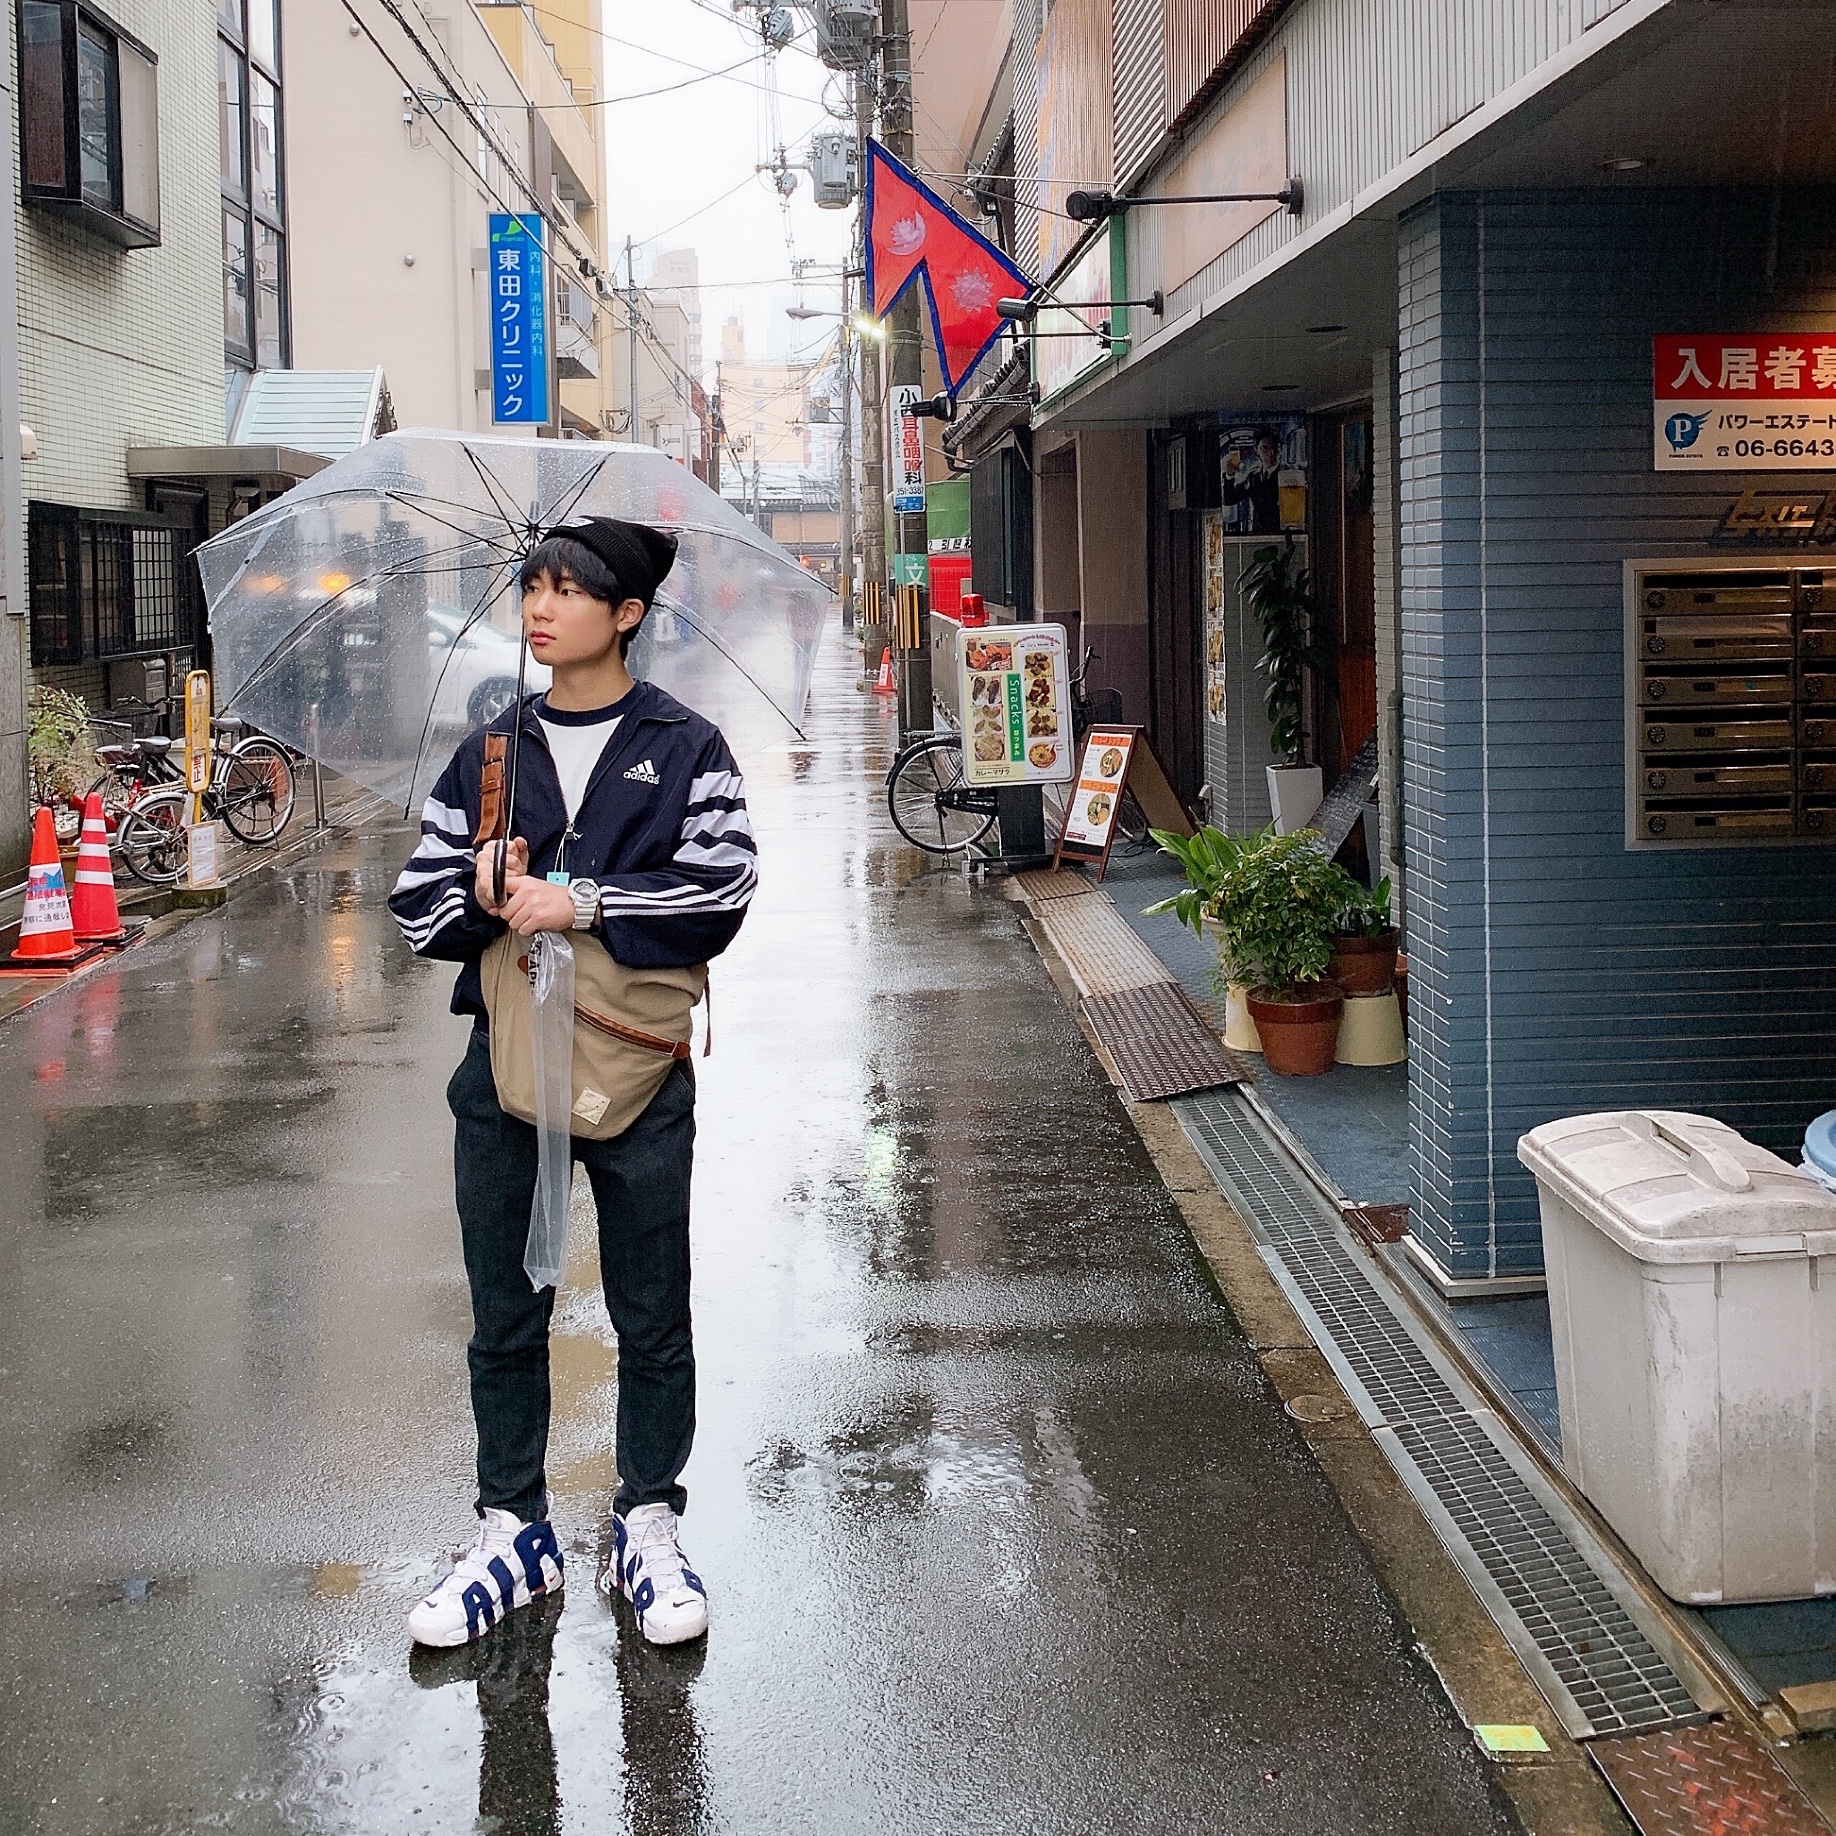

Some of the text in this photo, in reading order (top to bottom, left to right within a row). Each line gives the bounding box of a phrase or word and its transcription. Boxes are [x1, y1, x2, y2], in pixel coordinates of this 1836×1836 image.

[497, 248, 524, 417] 東田クリニック
[905, 562, 926, 586] 文
[1008, 679, 1023, 725] Snacks
[623, 771, 660, 785] adidas
[974, 769, 1010, 777] カレーマサラ
